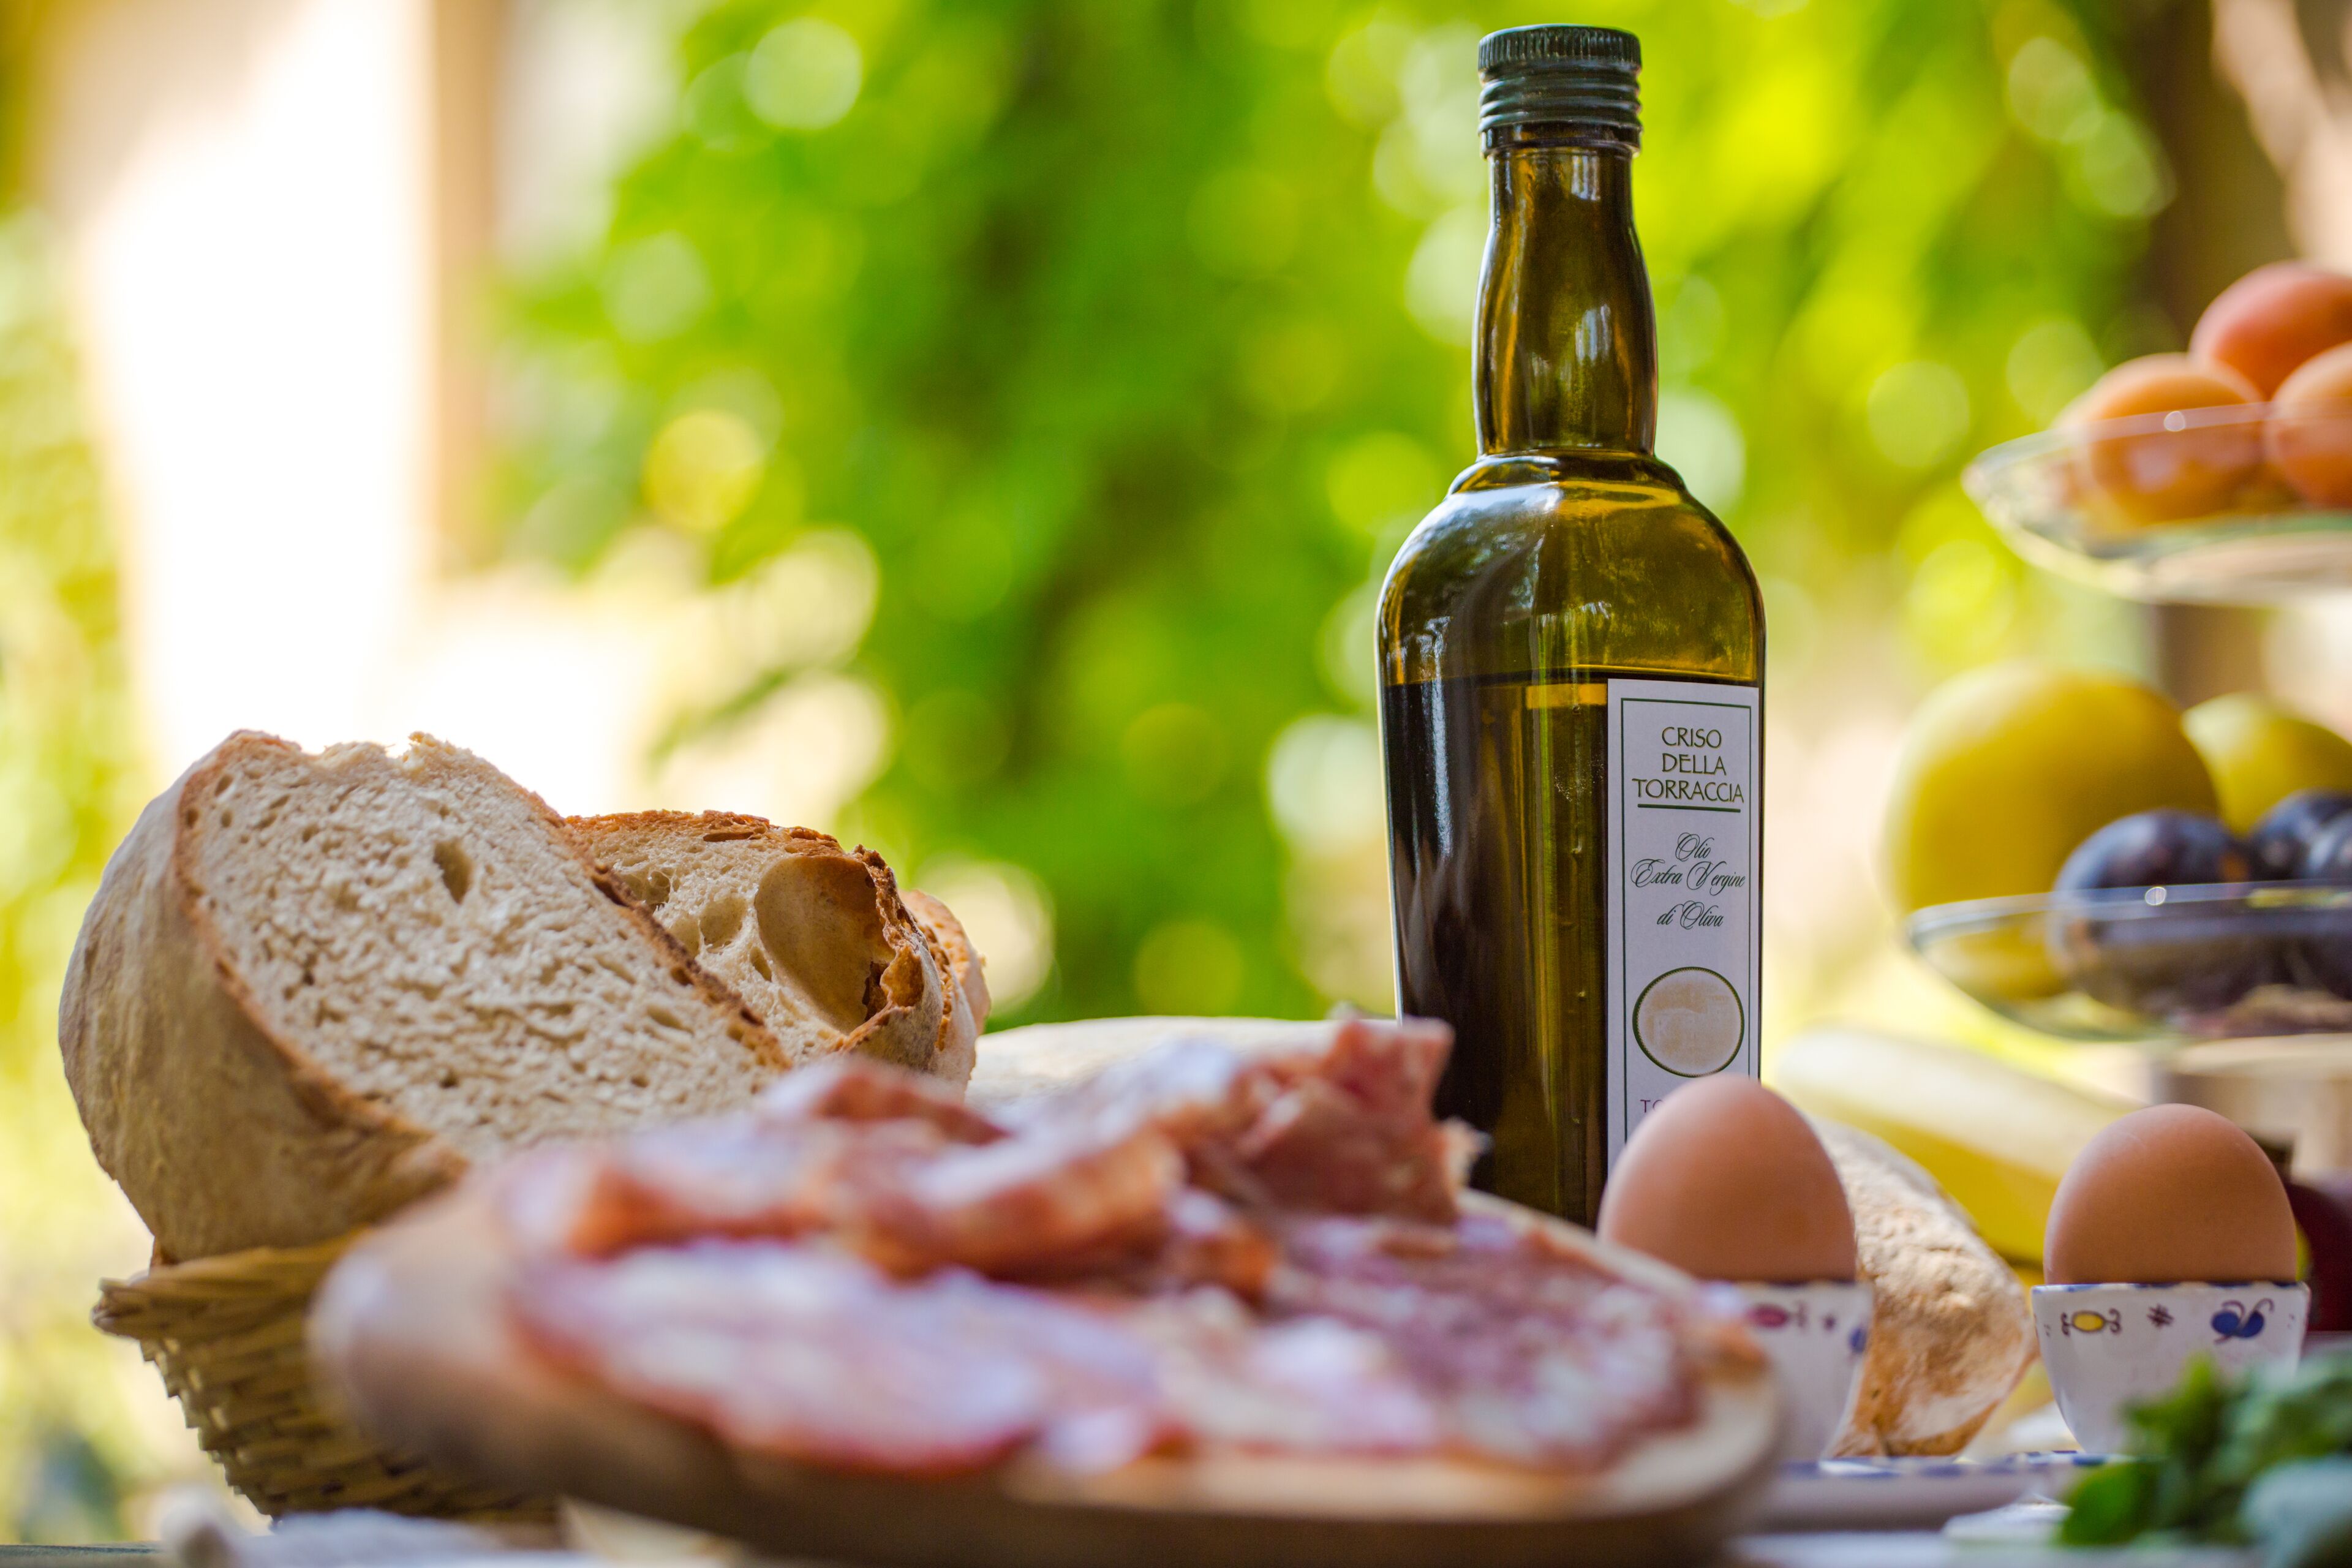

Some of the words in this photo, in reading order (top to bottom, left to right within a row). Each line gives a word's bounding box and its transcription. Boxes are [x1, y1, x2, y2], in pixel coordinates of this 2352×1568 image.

[1662, 726, 1722, 748] CRISO
[1662, 753, 1726, 775] DELLA
[1632, 778, 1744, 803] TORRACCIA
[1675, 832, 1714, 861] Olio
[1630, 858, 1683, 888] Extra
[1687, 861, 1745, 896] Vergine
[1656, 903, 1684, 925] di
[1680, 900, 1724, 930] Oliva
